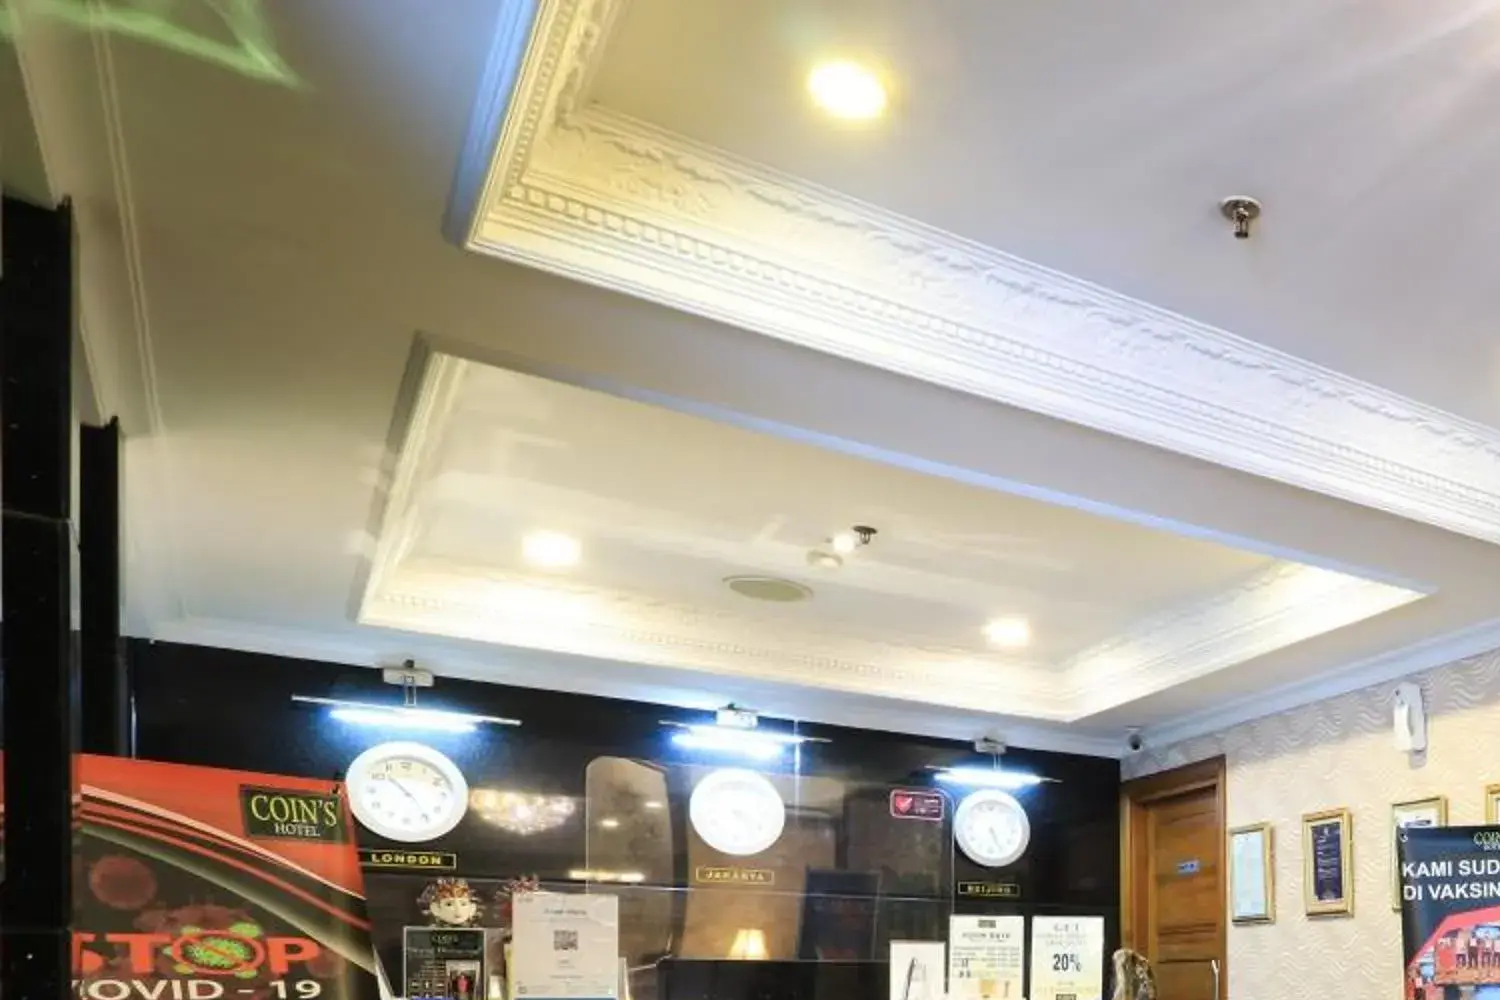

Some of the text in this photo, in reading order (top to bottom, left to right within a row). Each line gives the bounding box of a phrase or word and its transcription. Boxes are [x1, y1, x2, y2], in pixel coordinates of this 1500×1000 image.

[251, 795, 337, 826] COIN'S
[275, 823, 321, 837] HOTEL
[371, 853, 441, 865] LONDON
[1403, 861, 1453, 877] KAMI
[1403, 884, 1422, 900] DI
[73, 979, 225, 1000] OVID
[270, 979, 321, 1000] 19
